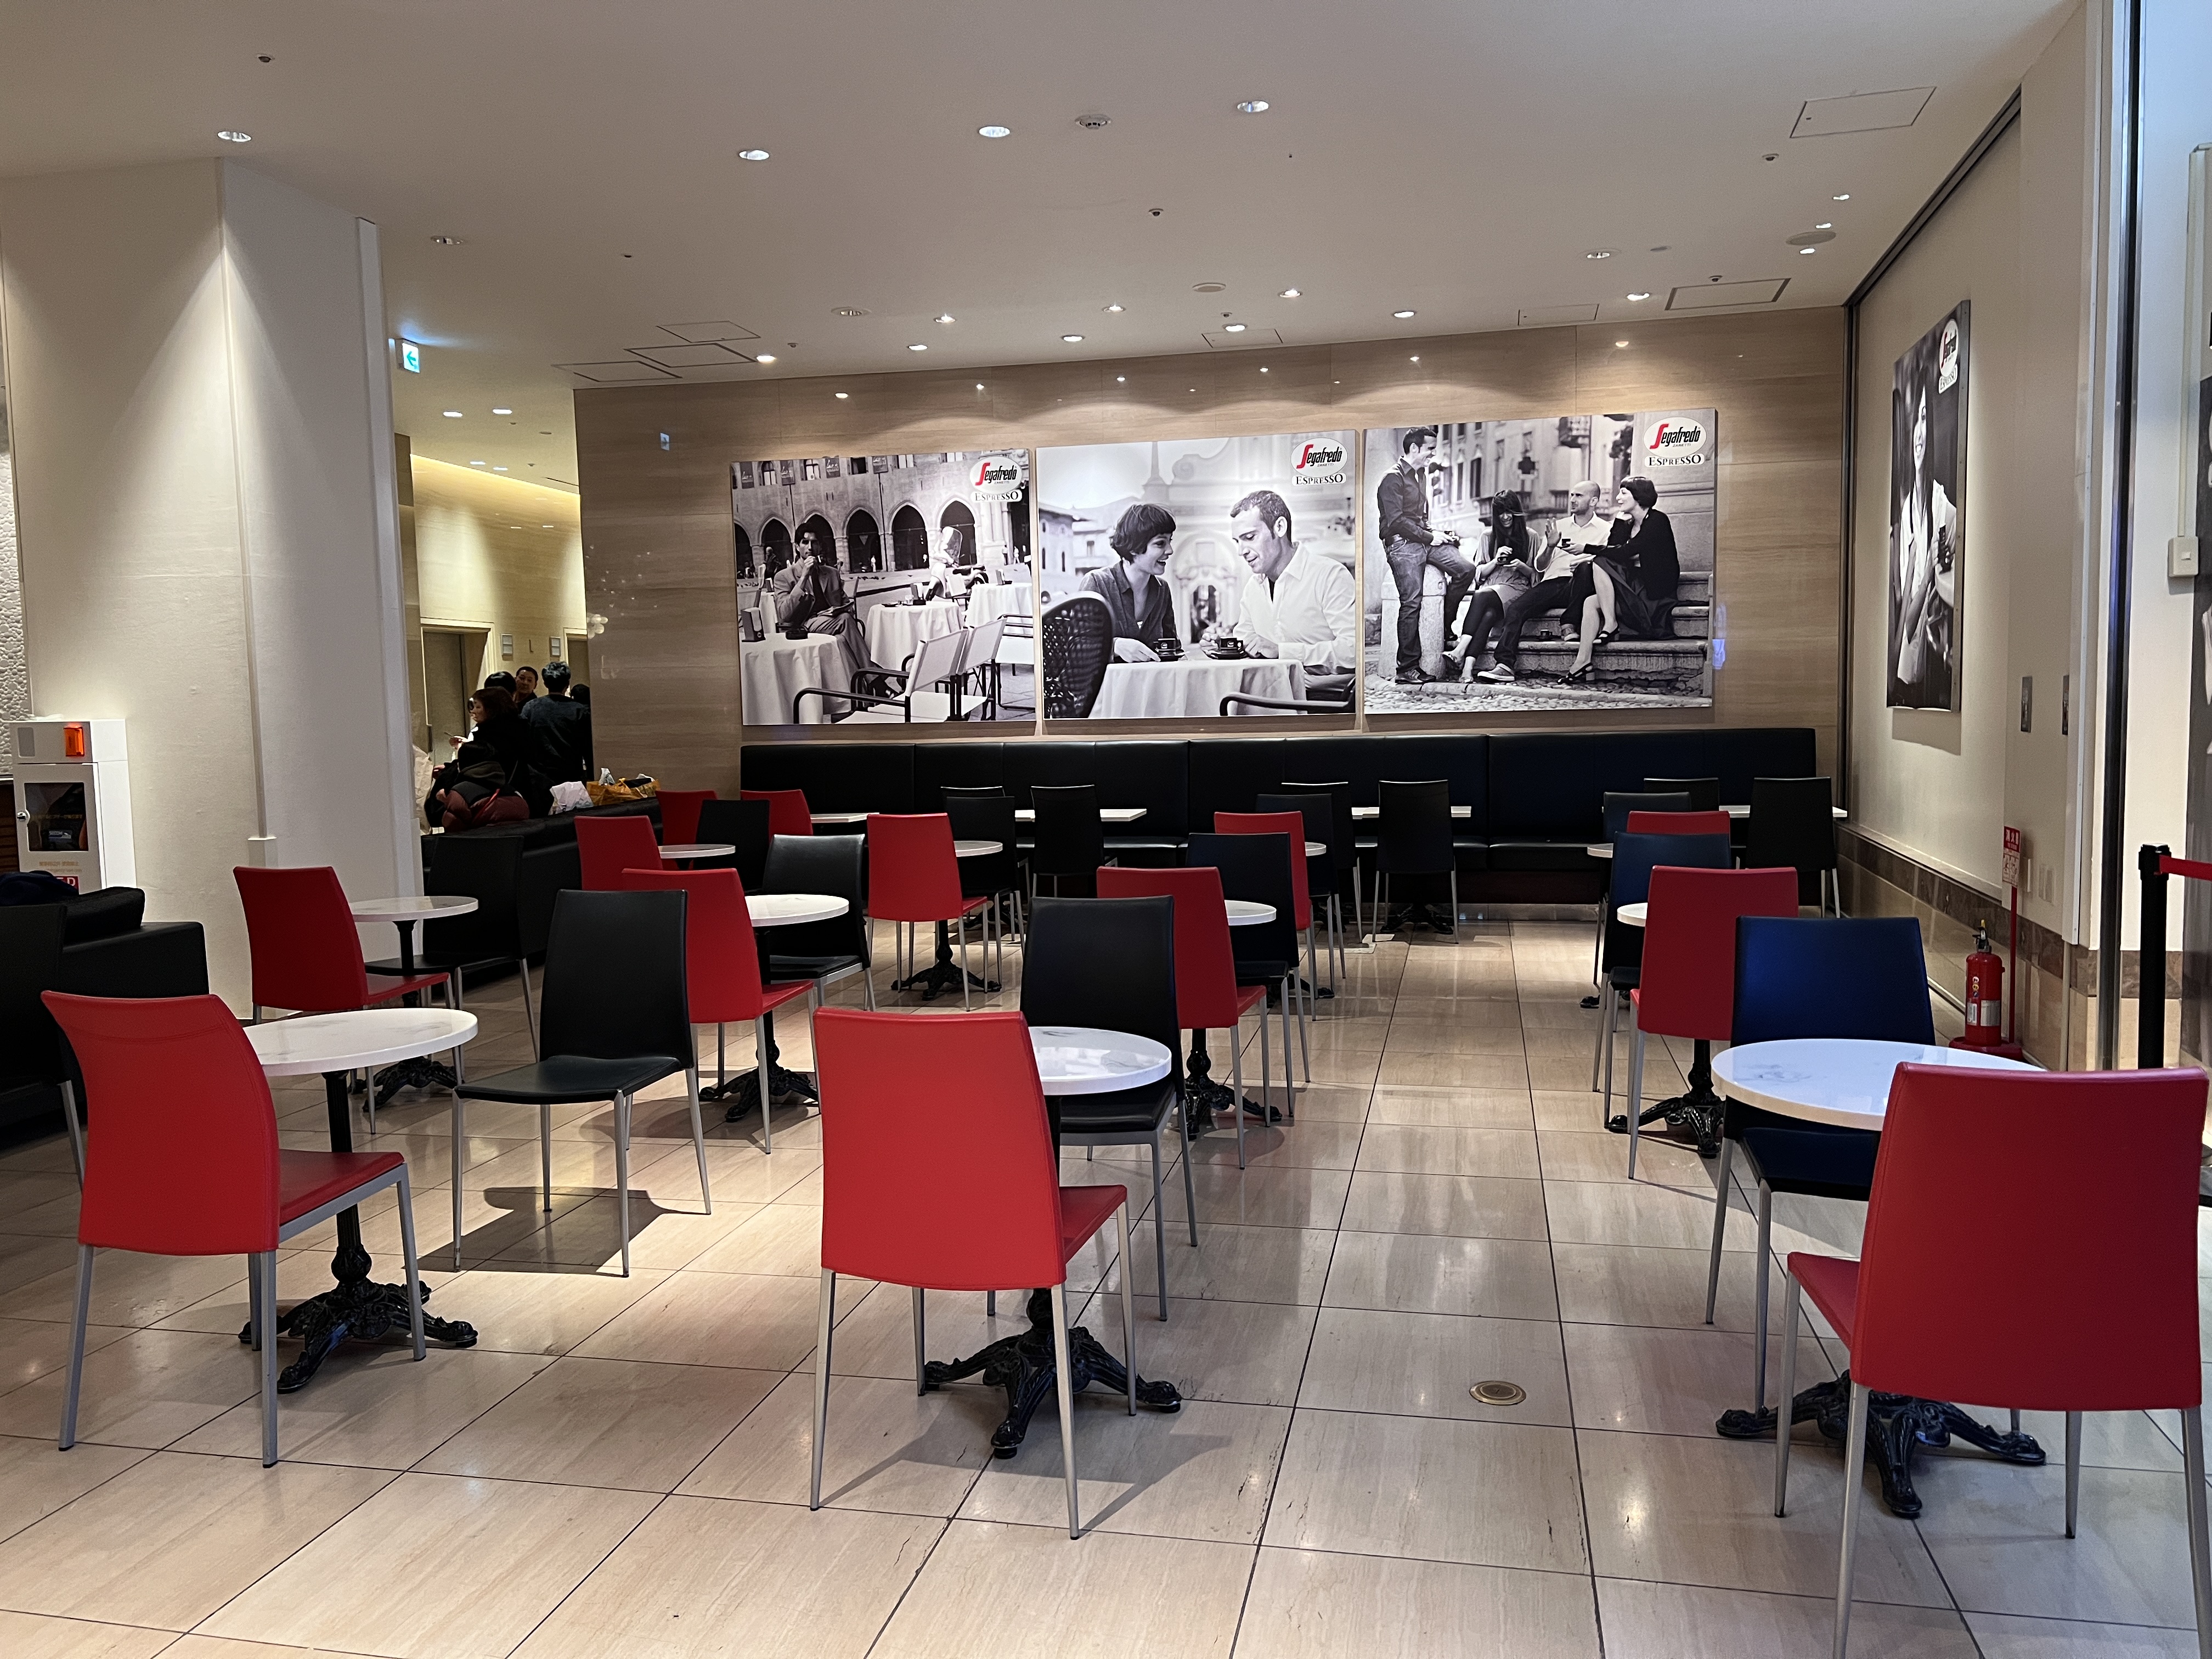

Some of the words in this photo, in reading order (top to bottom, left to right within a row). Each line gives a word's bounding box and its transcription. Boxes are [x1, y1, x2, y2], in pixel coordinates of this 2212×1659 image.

[1649, 424, 1701, 449] Segafredo
[1296, 444, 1342, 469] Segafredo
[1649, 454, 1701, 466] ESPRESSO
[975, 462, 1018, 486] Segafredo
[1296, 474, 1343, 485] ESPRESSO
[975, 491, 1018, 501] ESPRESSO
